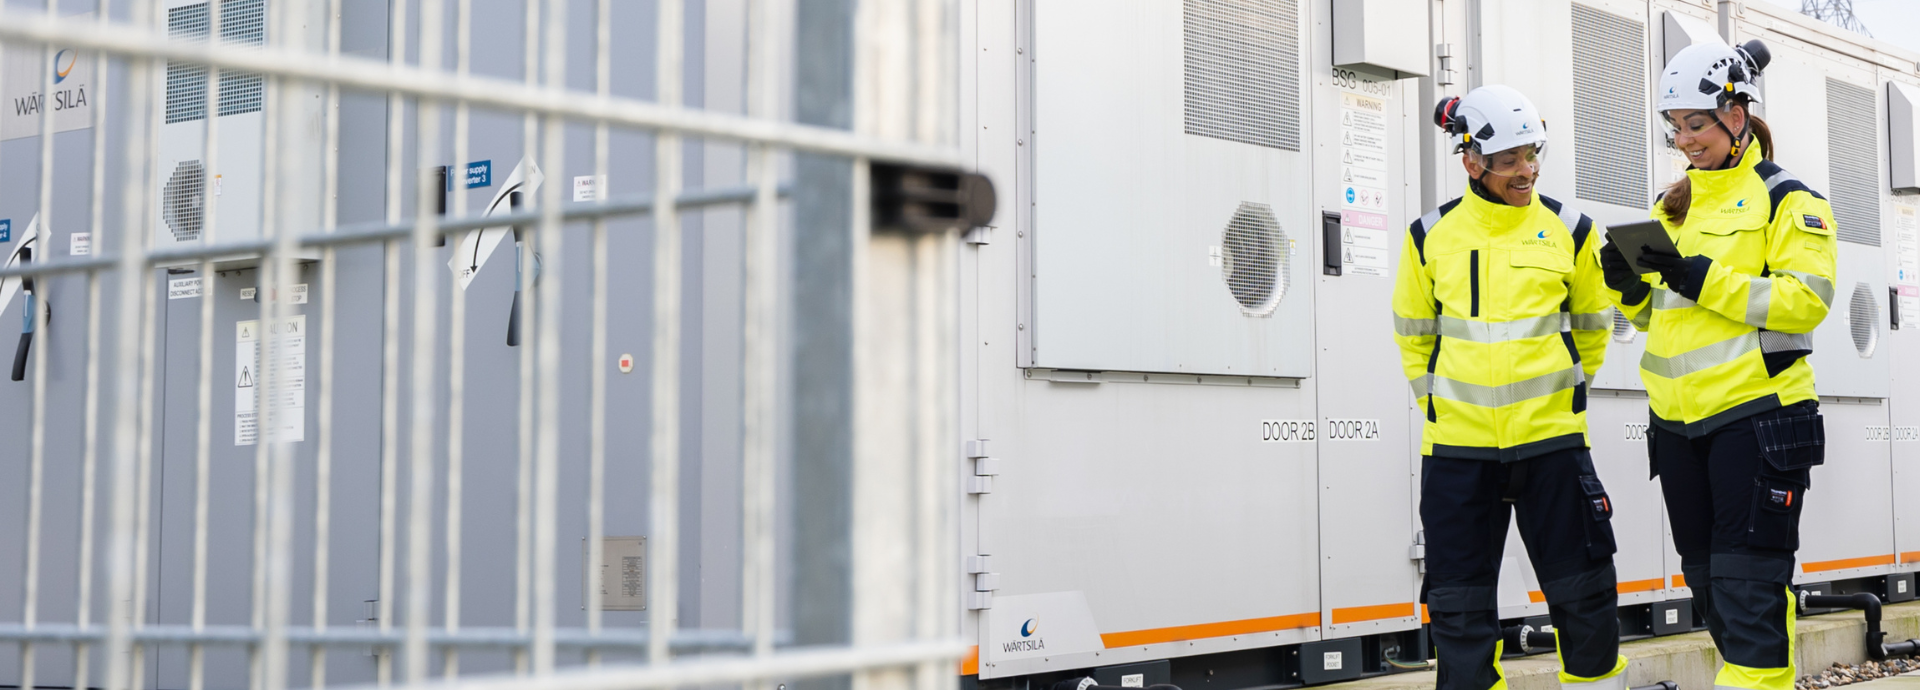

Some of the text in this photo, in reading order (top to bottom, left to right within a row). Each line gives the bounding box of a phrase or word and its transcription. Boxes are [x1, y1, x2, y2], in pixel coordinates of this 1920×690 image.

[1332, 67, 1391, 97] BSG 005-01
[14, 84, 87, 116] WÄRSILÄ
[1356, 98, 1382, 111] WARNING
[469, 164, 488, 176] supply
[481, 174, 487, 184] 3
[1358, 214, 1383, 227] DANGER
[241, 288, 255, 298] RESET
[269, 321, 298, 335] AUON
[1262, 421, 1316, 441] DOOR 2B
[1329, 420, 1379, 440] DOOR 2A
[1002, 637, 1045, 653] WÄRTSILÄ
